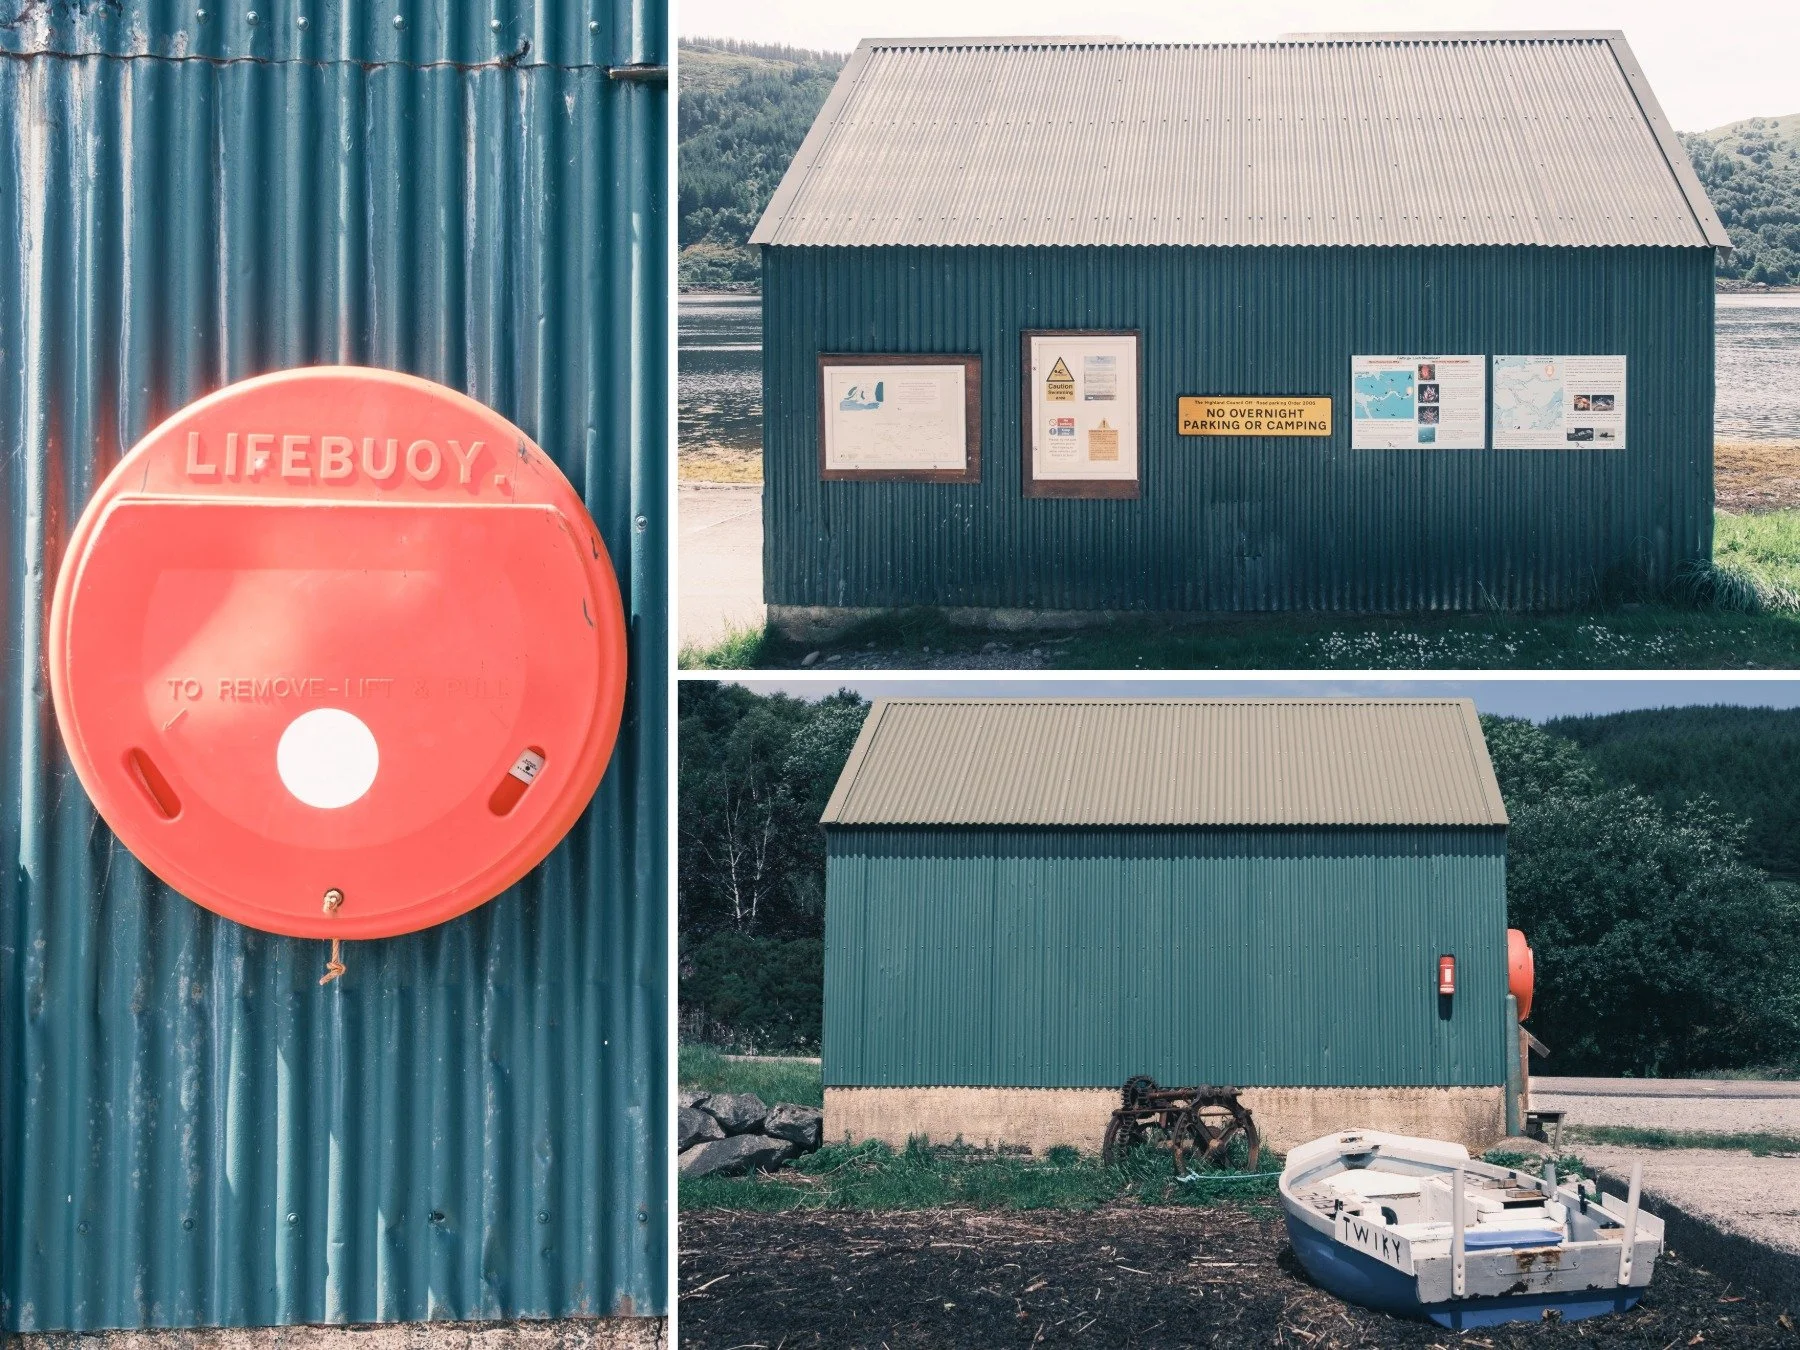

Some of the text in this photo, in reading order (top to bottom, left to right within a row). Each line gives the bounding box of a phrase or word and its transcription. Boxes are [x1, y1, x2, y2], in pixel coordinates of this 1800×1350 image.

[1206, 408, 1305, 419] NO OVERNIGHT
[1183, 420, 1327, 431] PARKING OR CAMPING
[167, 676, 204, 700] TO
[1343, 1216, 1401, 1265] TWIKY
